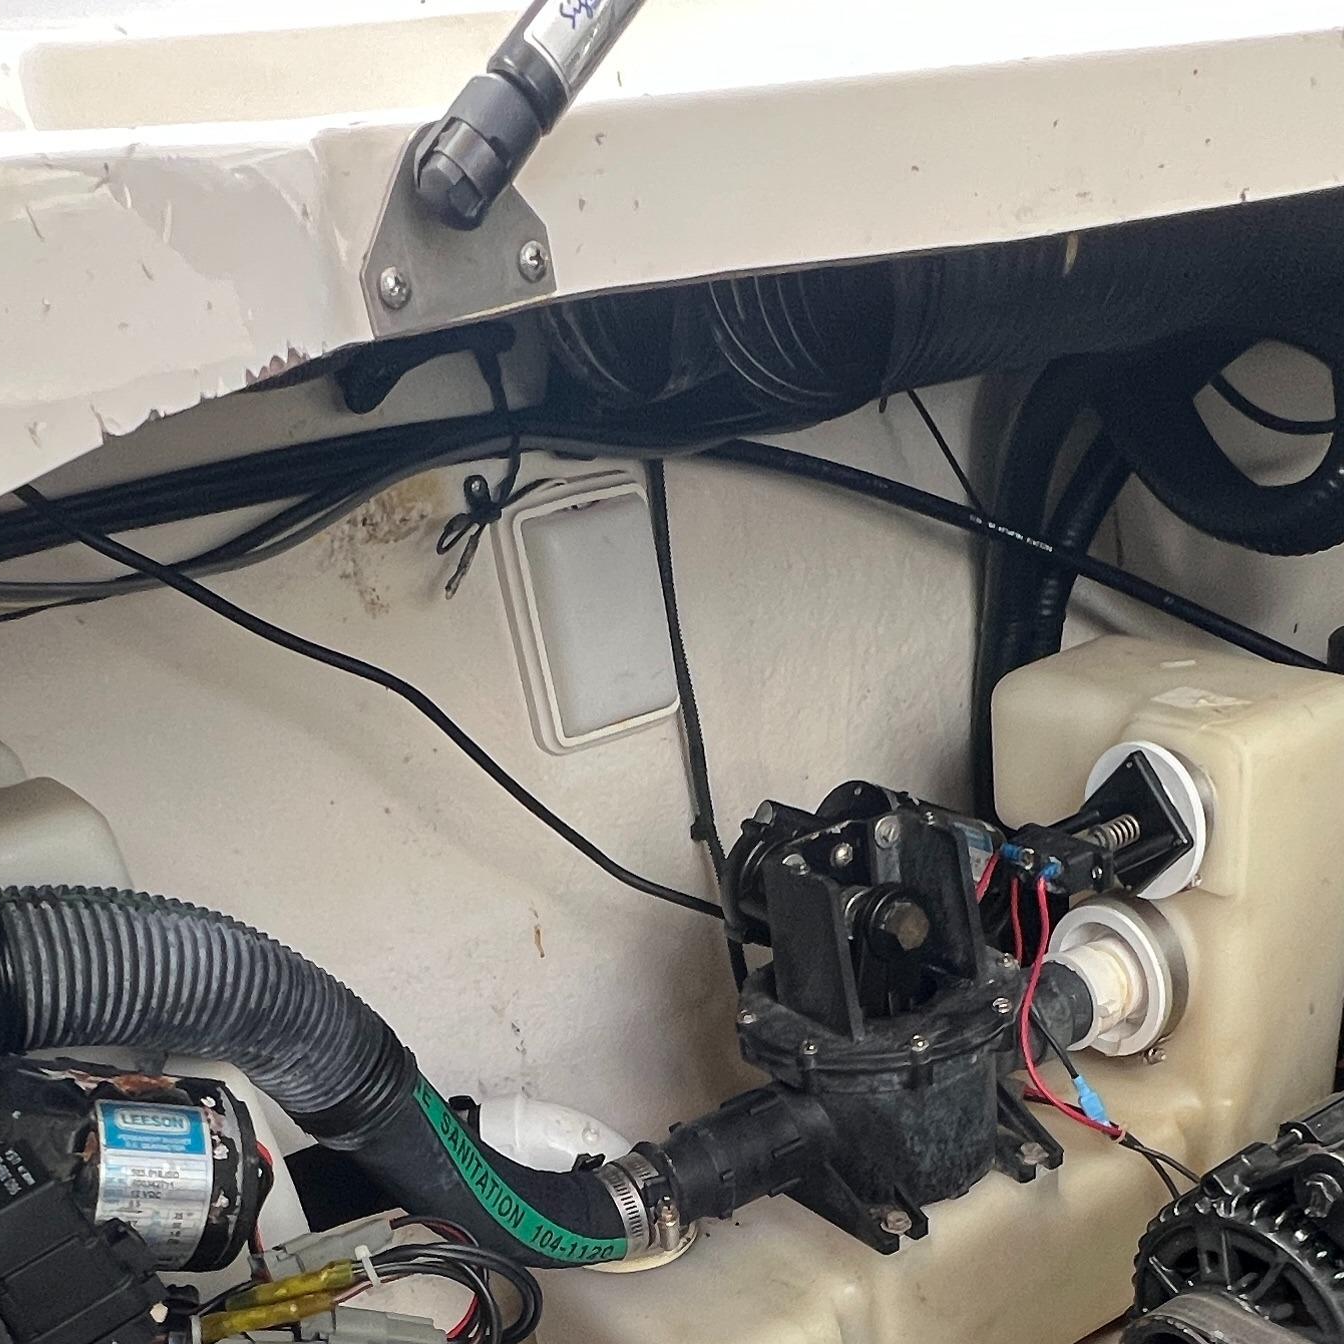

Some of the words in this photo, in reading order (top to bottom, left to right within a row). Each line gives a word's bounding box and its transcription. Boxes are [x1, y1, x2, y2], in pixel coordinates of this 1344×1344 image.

[120, 1112, 185, 1131] LEESON
[440, 1111, 524, 1229] SANITATION
[532, 1225, 613, 1260] 104-1120
